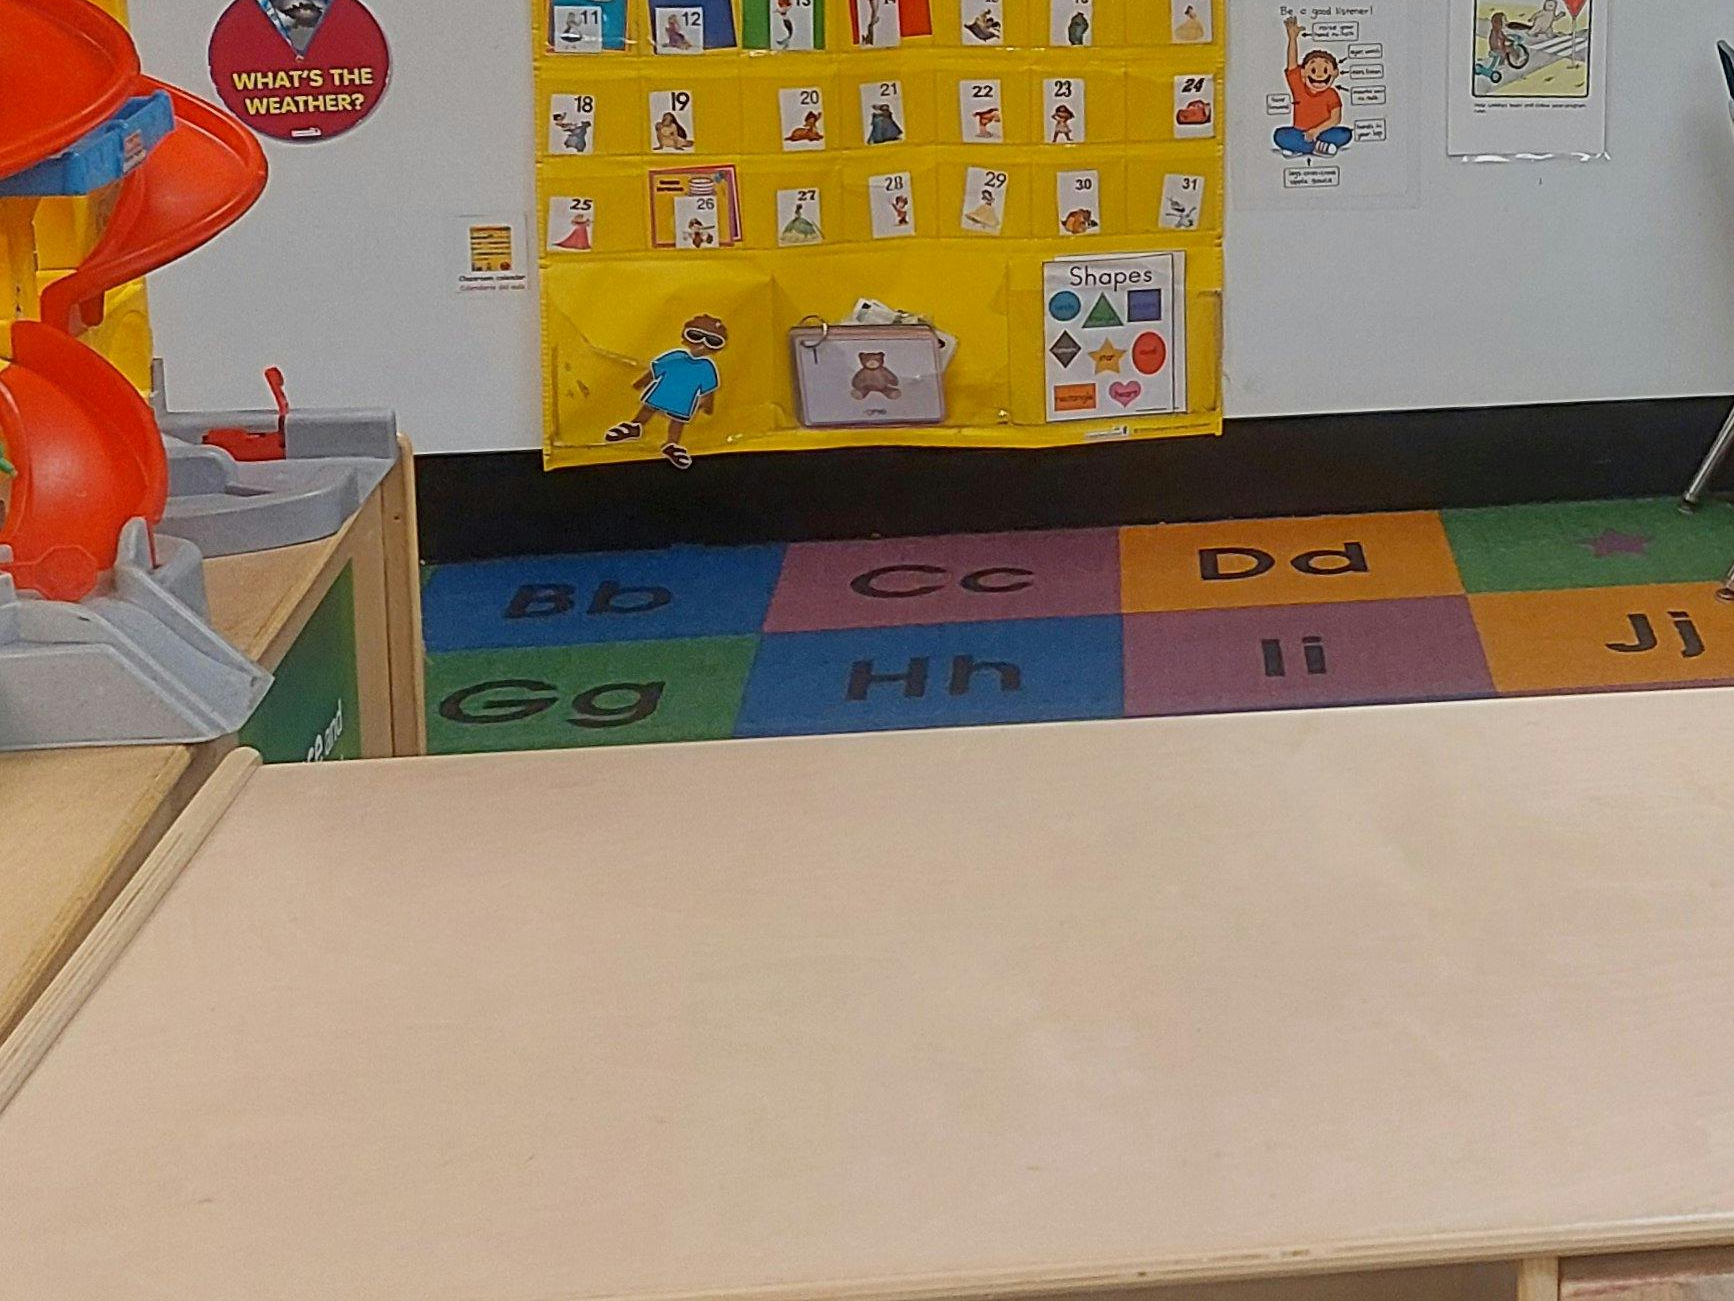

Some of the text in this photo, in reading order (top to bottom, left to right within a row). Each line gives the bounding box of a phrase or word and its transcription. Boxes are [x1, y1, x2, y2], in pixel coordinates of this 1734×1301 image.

[580, 10, 598, 25] 11
[683, 11, 701, 27] 12
[1280, 6, 1294, 16] Be
[1311, 6, 1332, 20] good
[232, 67, 374, 91] WHAT'S THE
[1181, 78, 1206, 94] 24
[800, 90, 819, 105] 20
[880, 82, 898, 97] 21
[972, 85, 994, 99] 22
[1054, 80, 1073, 98] 23
[244, 93, 365, 116] WEATHER?
[574, 95, 594, 113] 18
[671, 91, 690, 112] 19
[885, 176, 904, 192] 28
[984, 171, 1008, 189] 29
[1075, 178, 1093, 191] 30
[1182, 177, 1198, 191] 31
[570, 199, 593, 211] 25
[697, 198, 715, 211] 26
[797, 190, 816, 202] 27
[1069, 265, 1153, 292] Shapes
[1199, 540, 1370, 582] Dd
[850, 563, 1034, 600] Cc
[504, 579, 673, 619] Bb
[1605, 609, 1706, 658] Jj
[1260, 635, 1328, 678] Ii
[844, 652, 1022, 701] Hh
[439, 677, 667, 729] Gg
